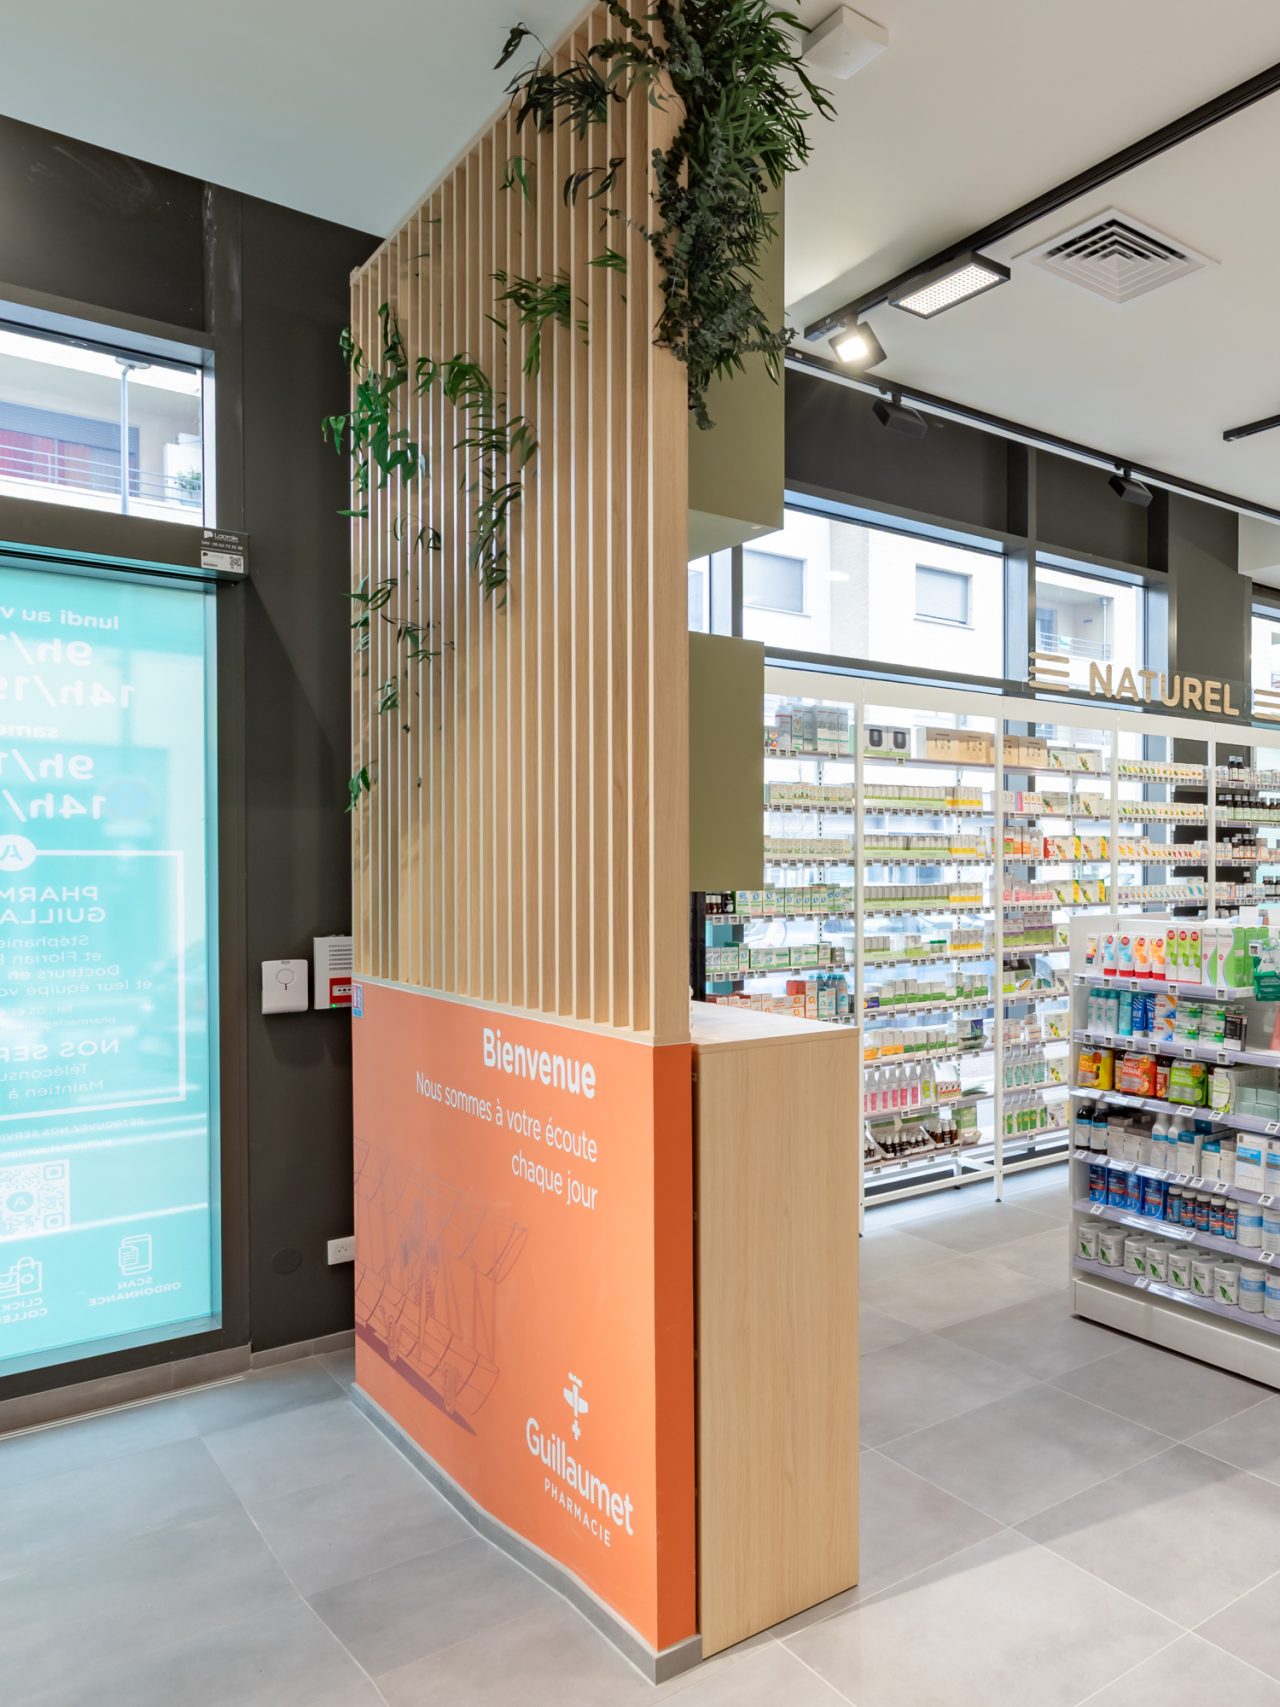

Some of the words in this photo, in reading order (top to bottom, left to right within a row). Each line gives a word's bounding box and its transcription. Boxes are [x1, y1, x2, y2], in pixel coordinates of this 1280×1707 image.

[1089, 662, 1240, 716] NATUREL
[483, 1027, 597, 1099] Bienvenue
[416, 1071, 442, 1101] Nous
[445, 1087, 492, 1122] sommes
[495, 1098, 503, 1126] à
[506, 1108, 541, 1141] votre
[545, 1117, 598, 1163] écoute
[512, 1150, 563, 1195] chaque
[567, 1170, 598, 1211] jour
[526, 1417, 634, 1536] Guillaumet
[544, 1478, 611, 1547] PHARMACIE
